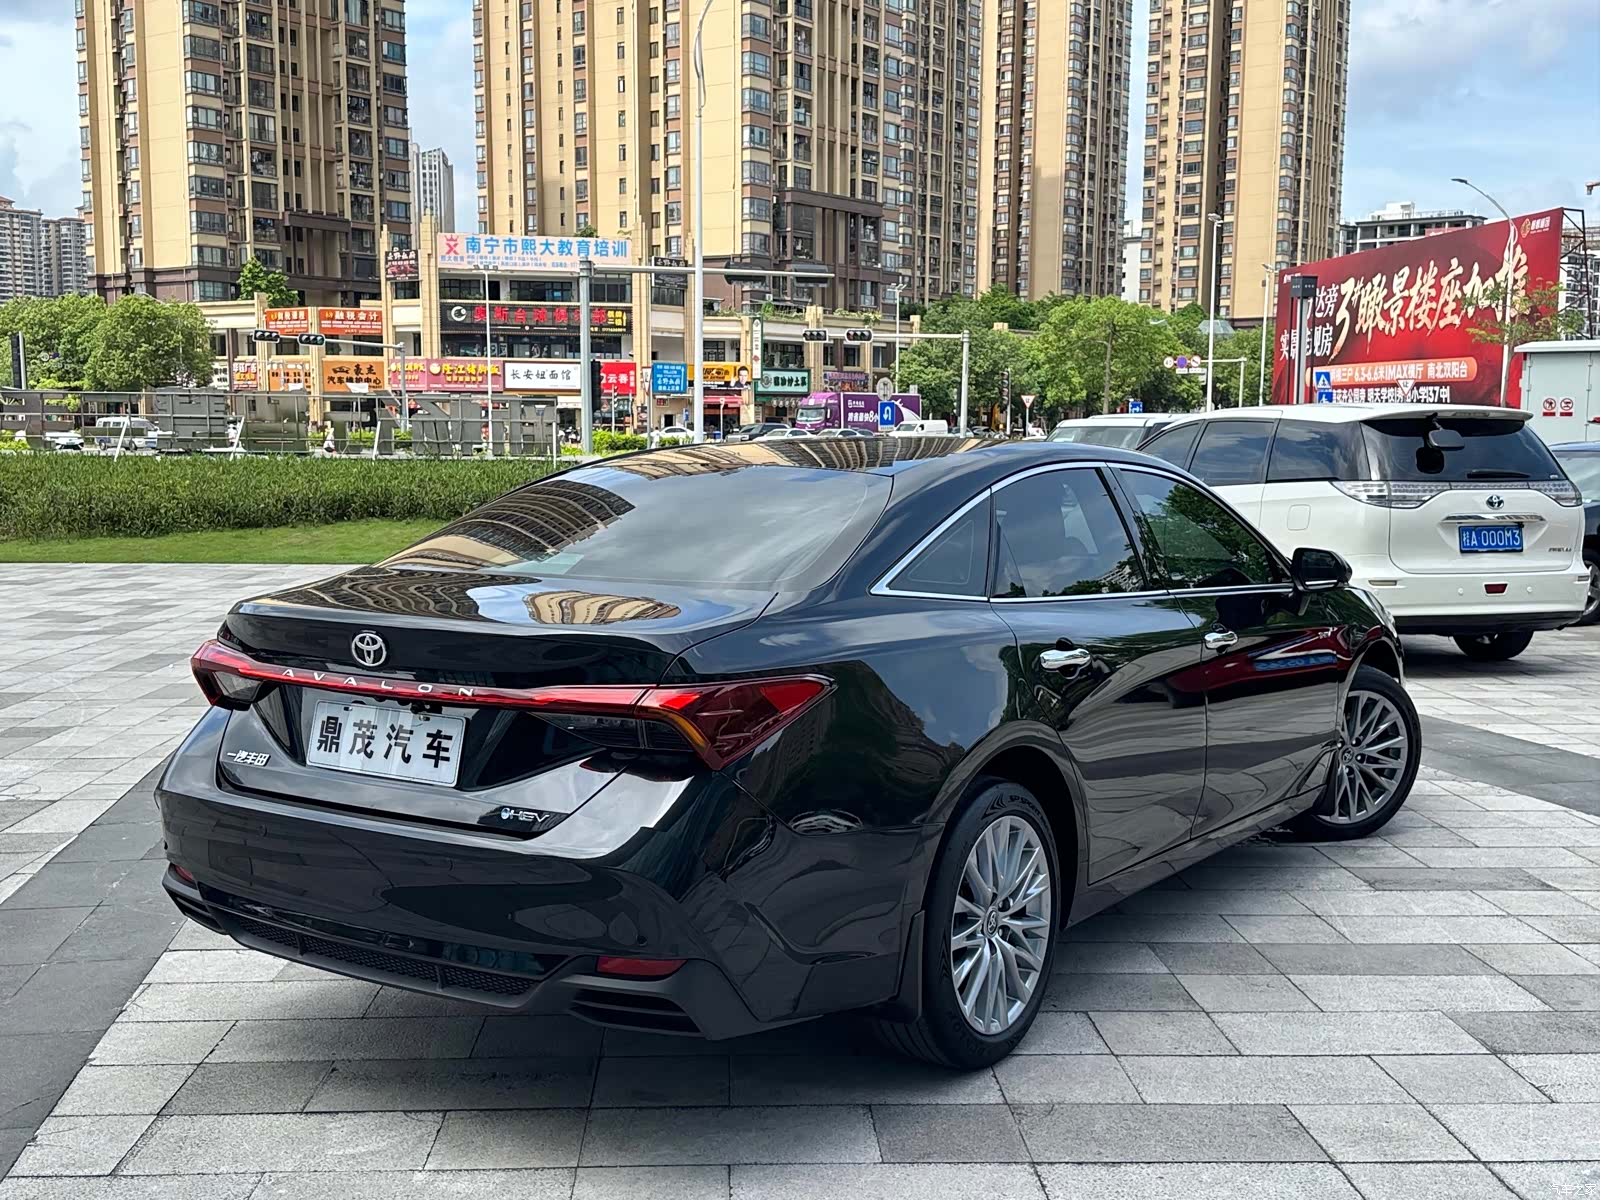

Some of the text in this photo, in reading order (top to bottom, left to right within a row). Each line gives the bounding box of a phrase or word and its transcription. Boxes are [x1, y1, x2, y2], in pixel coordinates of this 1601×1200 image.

[465, 236, 627, 258] 南宁市熙大教育培训
[1427, 360, 1468, 380] 南北双阳台
[282, 667, 475, 698] AVALON
[316, 715, 453, 769] 鼎茂汽车
[226, 749, 271, 767] 一汽丰田
[509, 809, 550, 823] HEV
